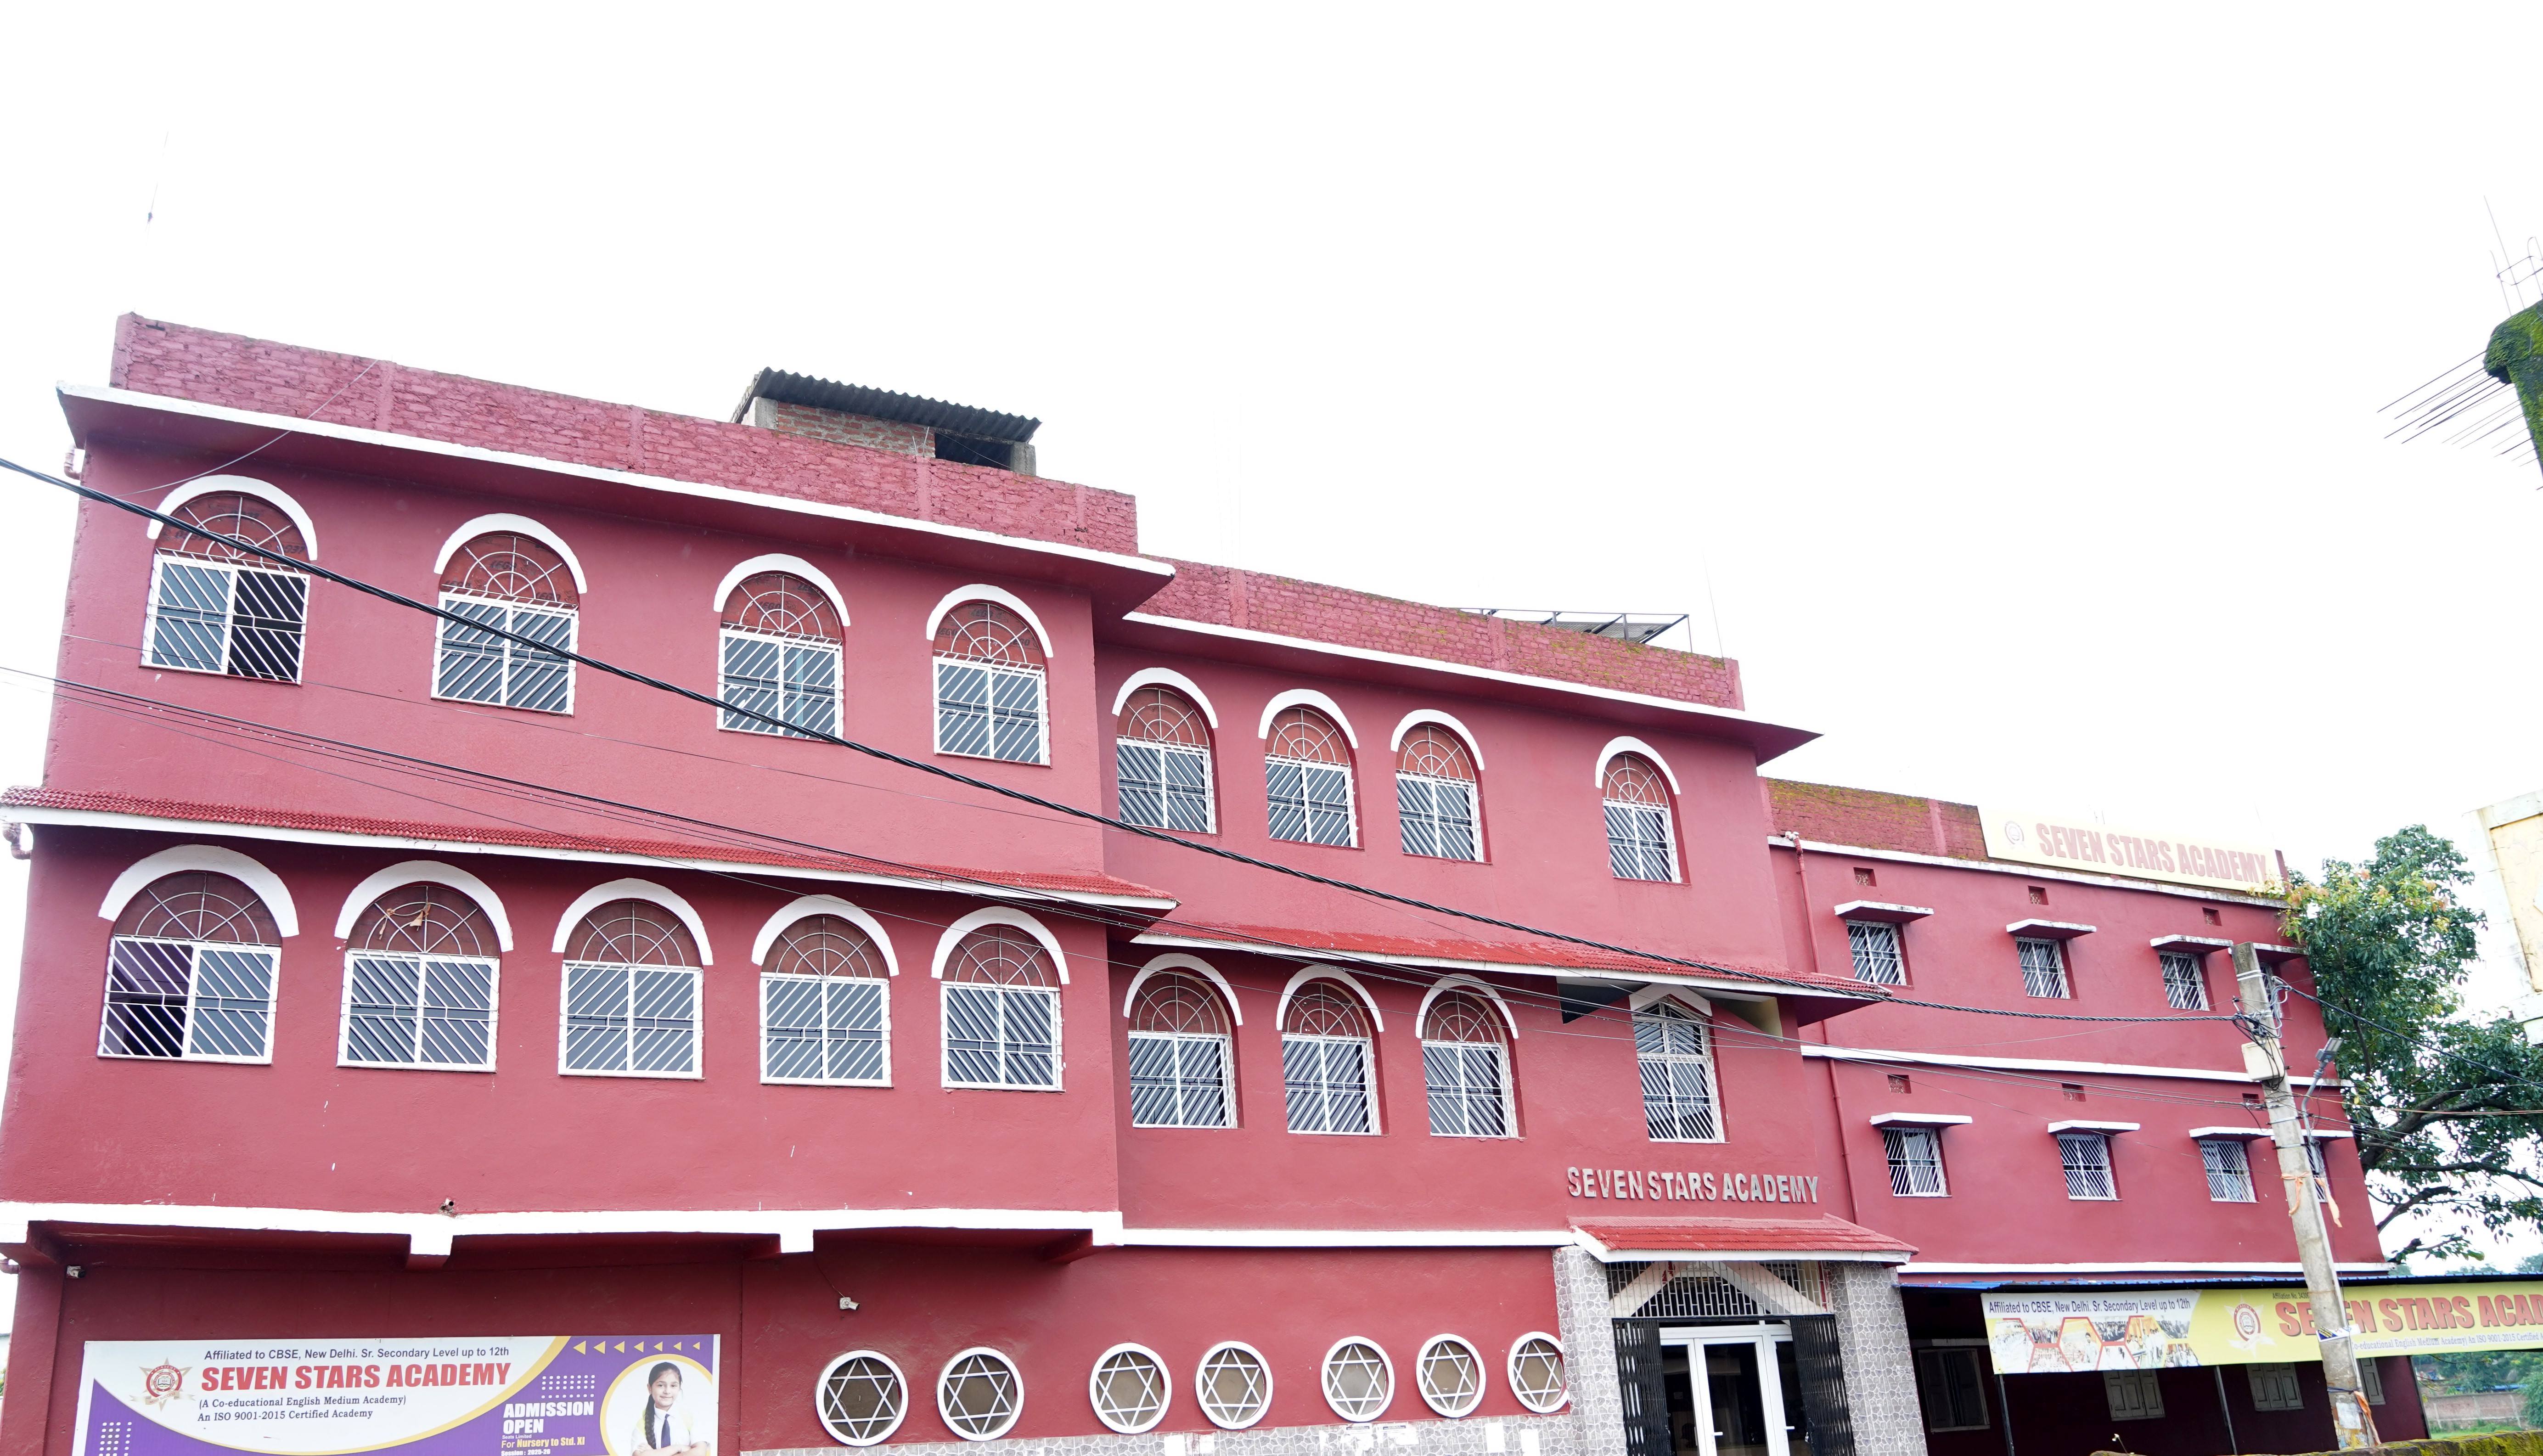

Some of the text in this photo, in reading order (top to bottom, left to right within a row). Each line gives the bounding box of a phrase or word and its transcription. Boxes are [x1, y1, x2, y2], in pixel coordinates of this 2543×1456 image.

[2036, 823, 2267, 883] SEVEN STARS ACADEMY
[1567, 1167, 1818, 1203] SEVEN STARS ACADEMY
[1989, 1298, 2191, 1314] Affiliated to CBSE, New Delhi. Sr. Secondary Level up to 12th
[2275, 1300, 2377, 1337] SEN
[2379, 1296, 2475, 1332] STARS
[2395, 1338, 2416, 1349] English
[2417, 1337, 2439, 1345] Medium
[2476, 1335, 2486, 1343] ISO
[2487, 1333, 2515, 1343] 9001-2015
[2516, 1332, 2538, 1341] Certified
[204, 1350, 252, 1360] Affiliated
[269, 1349, 301, 1360] CBSE,
[305, 1349, 326, 1358] New
[330, 1349, 357, 1358] Delhi.
[361, 1349, 374, 1357] Sr.
[377, 1348, 429, 1359] Secondary
[433, 1348, 458, 1356] Level
[489, 1347, 509, 1355] 12th
[202, 1366, 288, 1391] SEVEN
[295, 1364, 380, 1389] STARS
[386, 1363, 511, 1387] ACADEMY
[199, 1395, 406, 1409] (A Co-educational English Medium Academy)
[503, 1401, 594, 1418] ADMISSION
[214, 1412, 231, 1421] ISO
[235, 1411, 285, 1420] 9001-2015
[289, 1410, 328, 1418] Certified
[332, 1409, 373, 1419] Academy
[503, 1419, 544, 1434] OPEN
[517, 1439, 549, 1448] Nursery
[561, 1437, 575, 1445] Std.
[577, 1437, 585, 1445] XI
